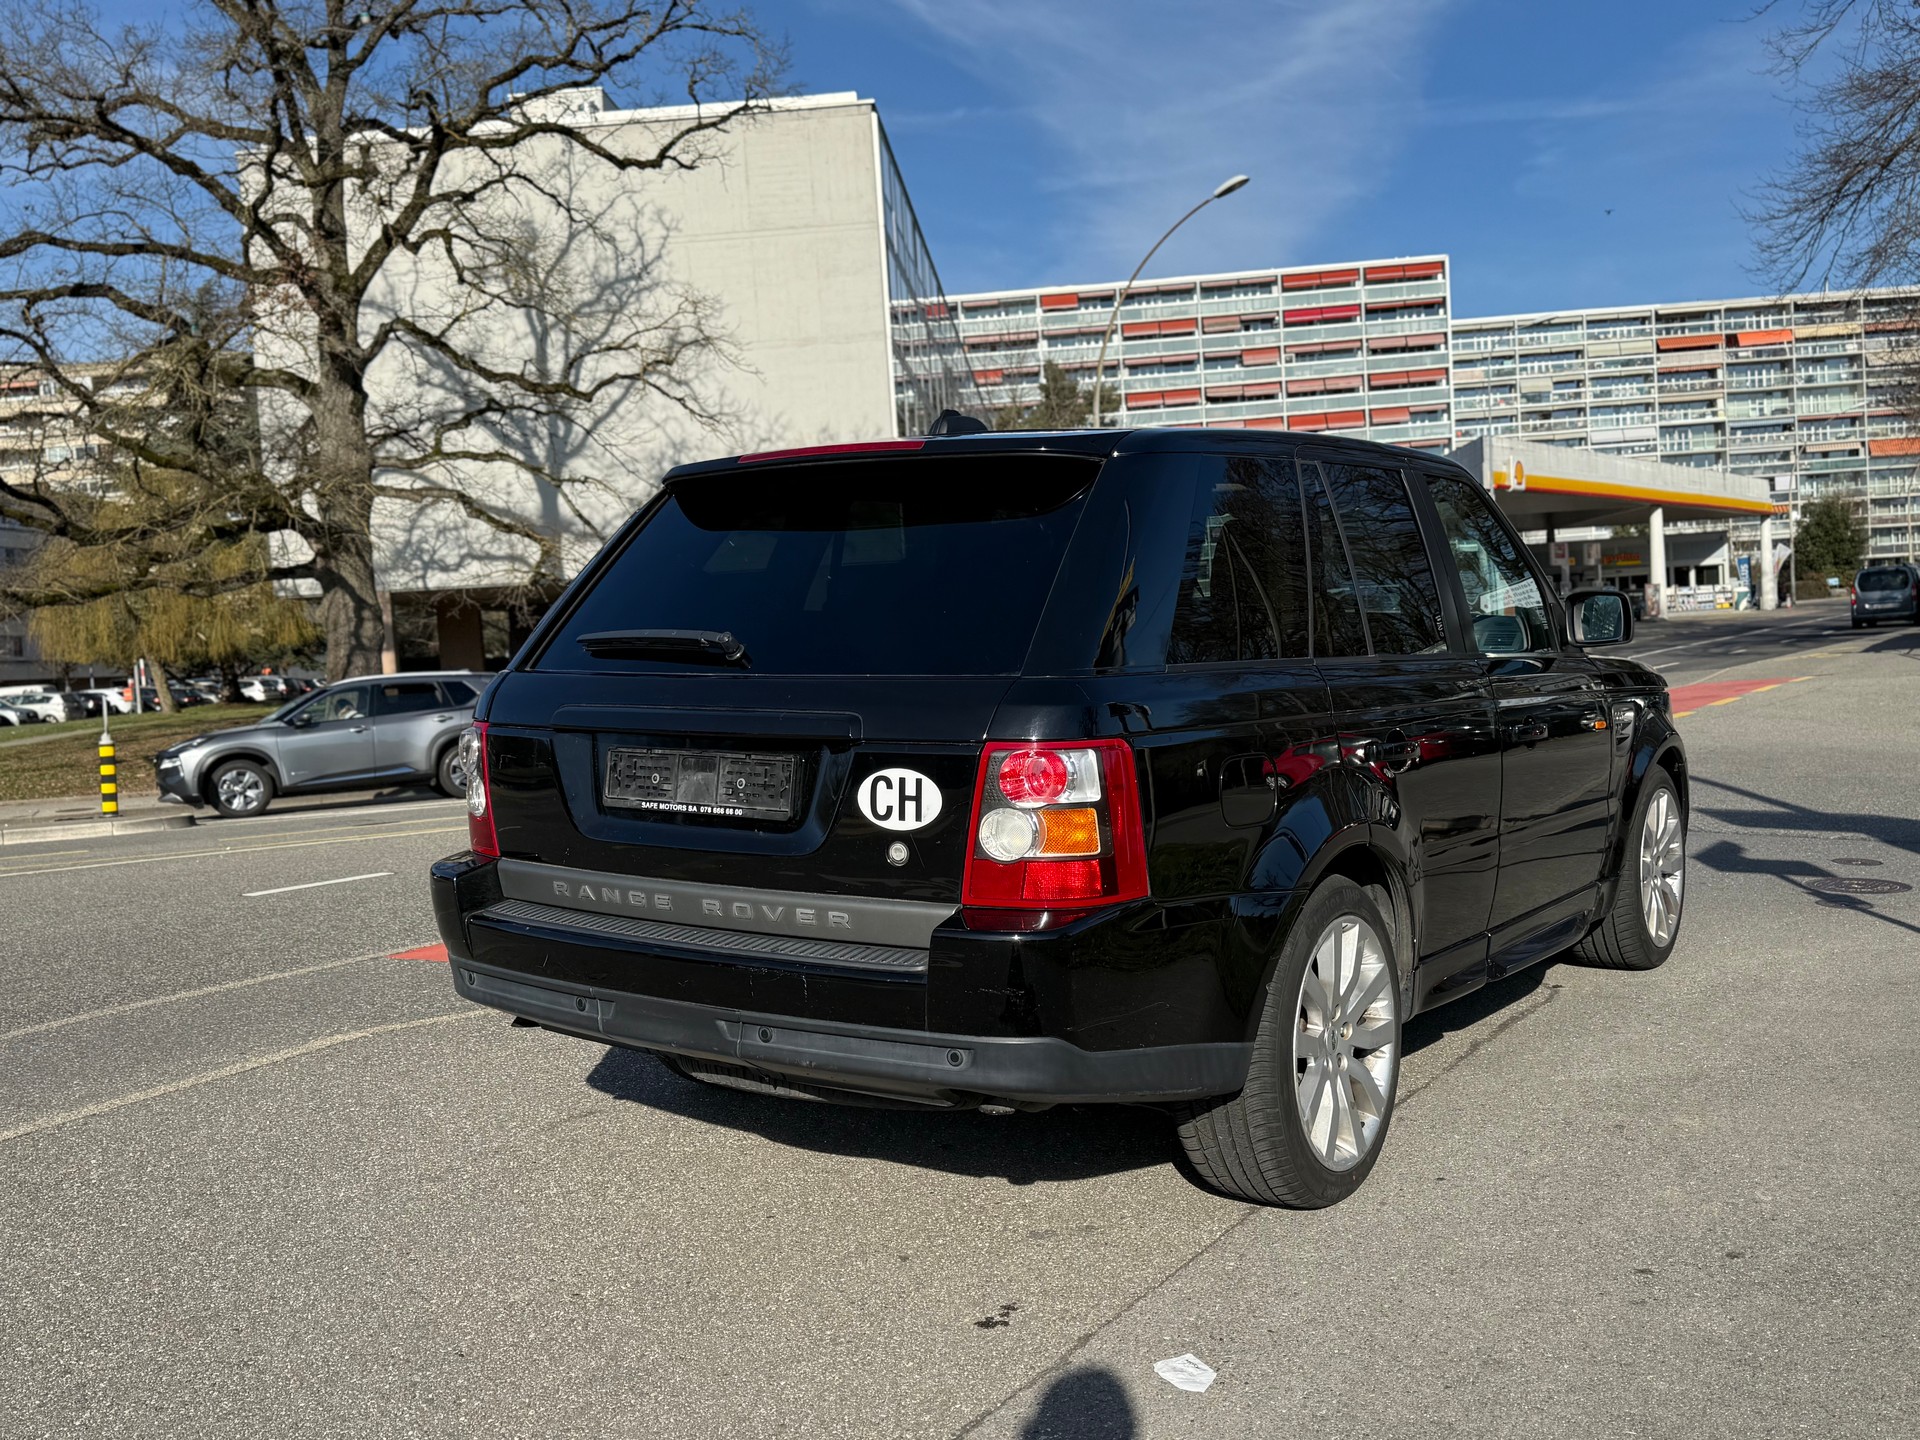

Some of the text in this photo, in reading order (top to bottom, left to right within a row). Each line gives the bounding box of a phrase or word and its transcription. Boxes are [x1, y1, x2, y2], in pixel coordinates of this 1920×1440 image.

[641, 801, 658, 810] SAFE
[659, 803, 687, 812] MOTORS
[688, 805, 698, 813] SA
[700, 805, 712, 814] 078
[735, 808, 743, 816] 00
[870, 775, 922, 822] CH
[553, 880, 851, 929] RANGE ROVER
